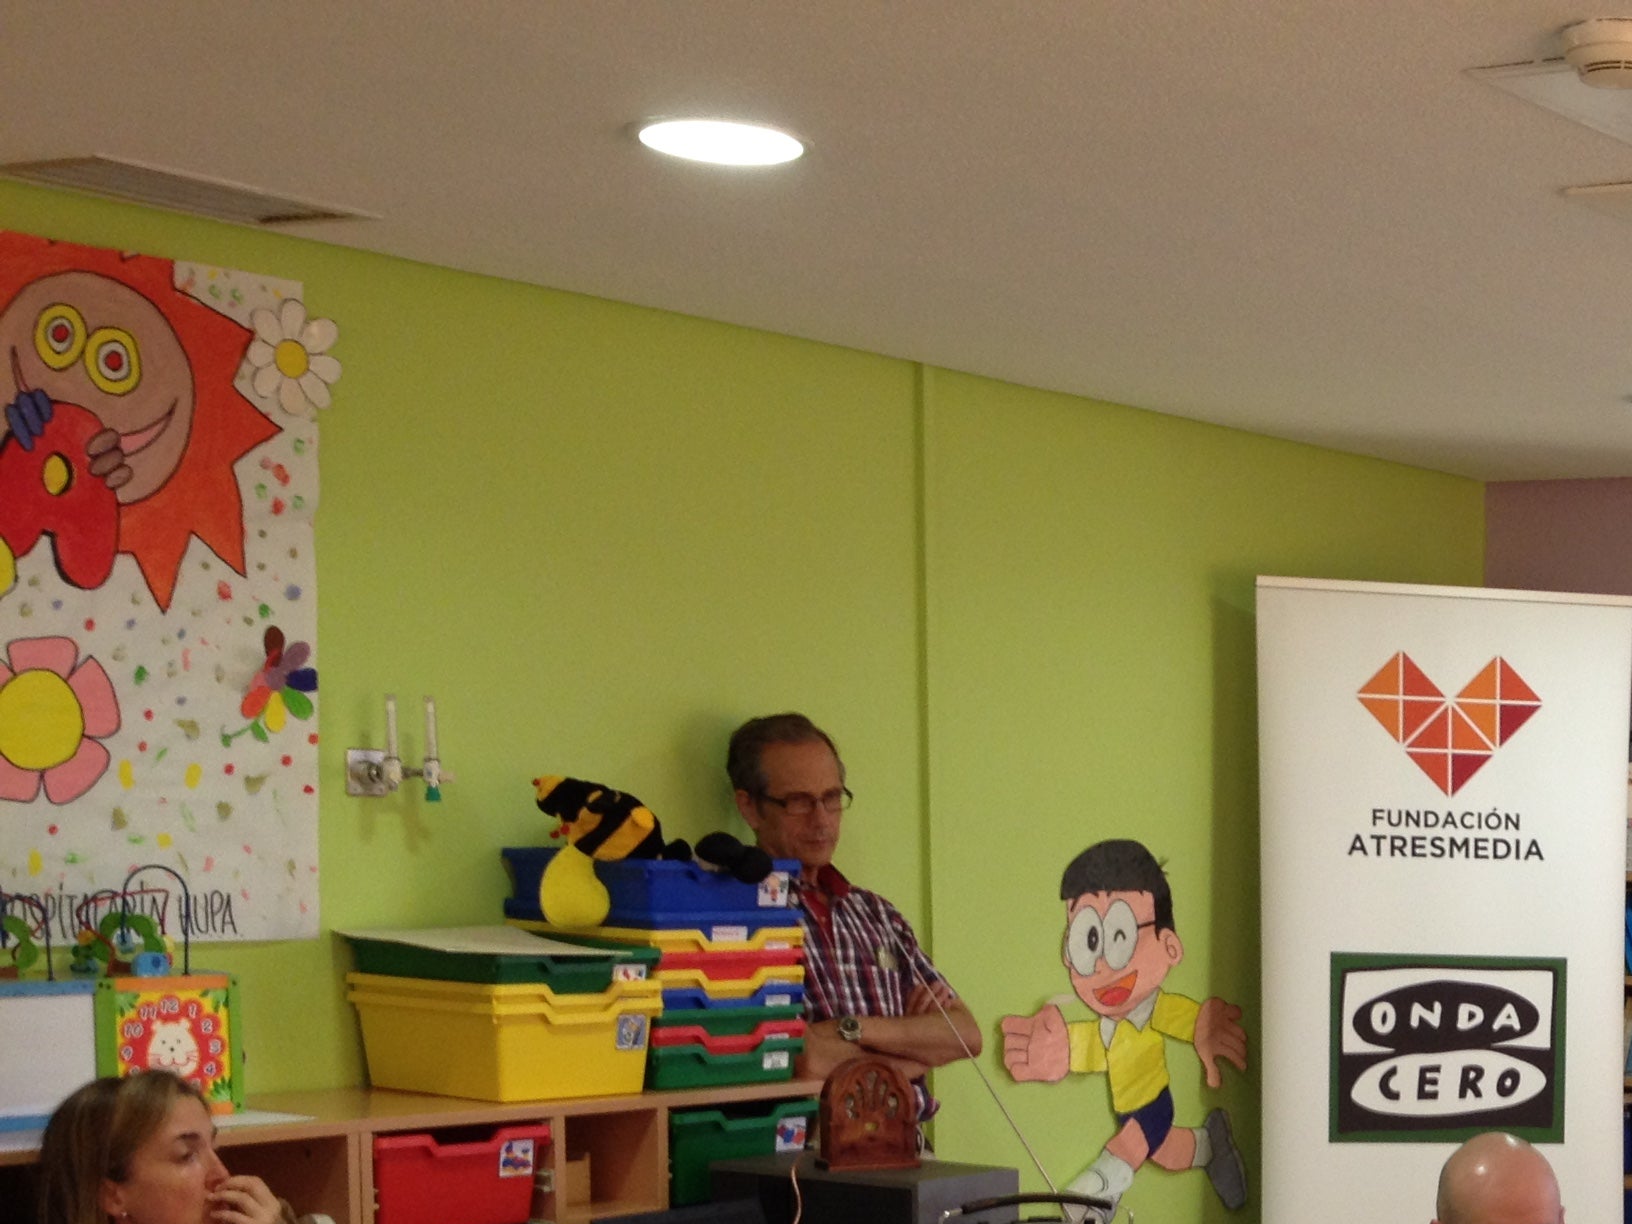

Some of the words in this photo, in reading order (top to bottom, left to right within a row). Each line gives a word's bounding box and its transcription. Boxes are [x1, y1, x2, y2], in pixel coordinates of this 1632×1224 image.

[1372, 807, 1521, 831] FUNDACIÓN
[1347, 833, 1544, 861] ATRESMEDIA
[140, 1006, 158, 1020] 11
[160, 999, 179, 1014] 12
[201, 1018, 213, 1034] 2
[1370, 1000, 1522, 1036] ONDA
[124, 1023, 144, 1039] 10
[121, 1046, 134, 1061] 9
[209, 1039, 222, 1055] 3
[204, 1061, 217, 1077] 4
[1379, 1063, 1521, 1101] CERO
